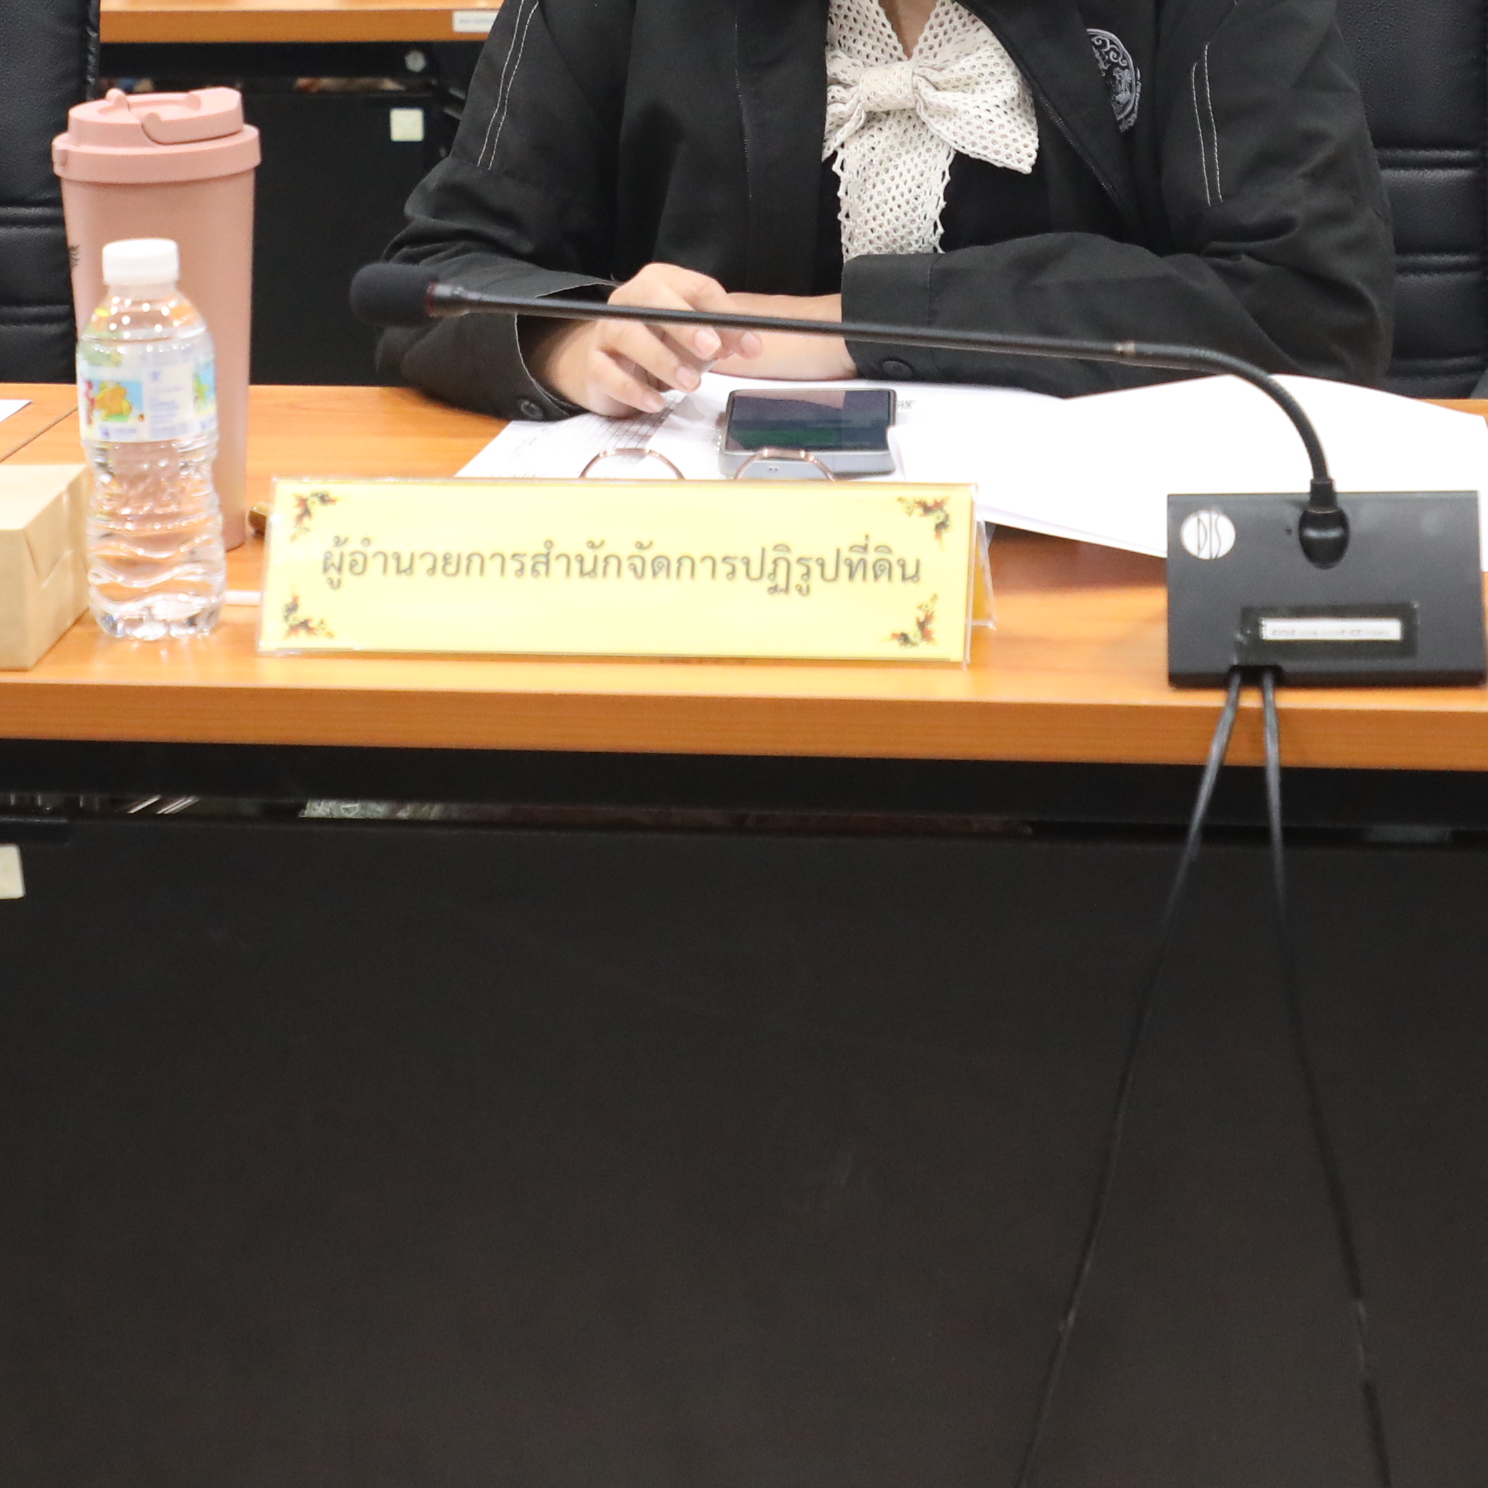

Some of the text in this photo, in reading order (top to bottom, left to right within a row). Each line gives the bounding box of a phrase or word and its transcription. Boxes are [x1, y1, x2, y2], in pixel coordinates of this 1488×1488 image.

[321, 533, 922, 596] ผู้อำนวยการสำนักจัดการปฏิรูปที่ดิน
